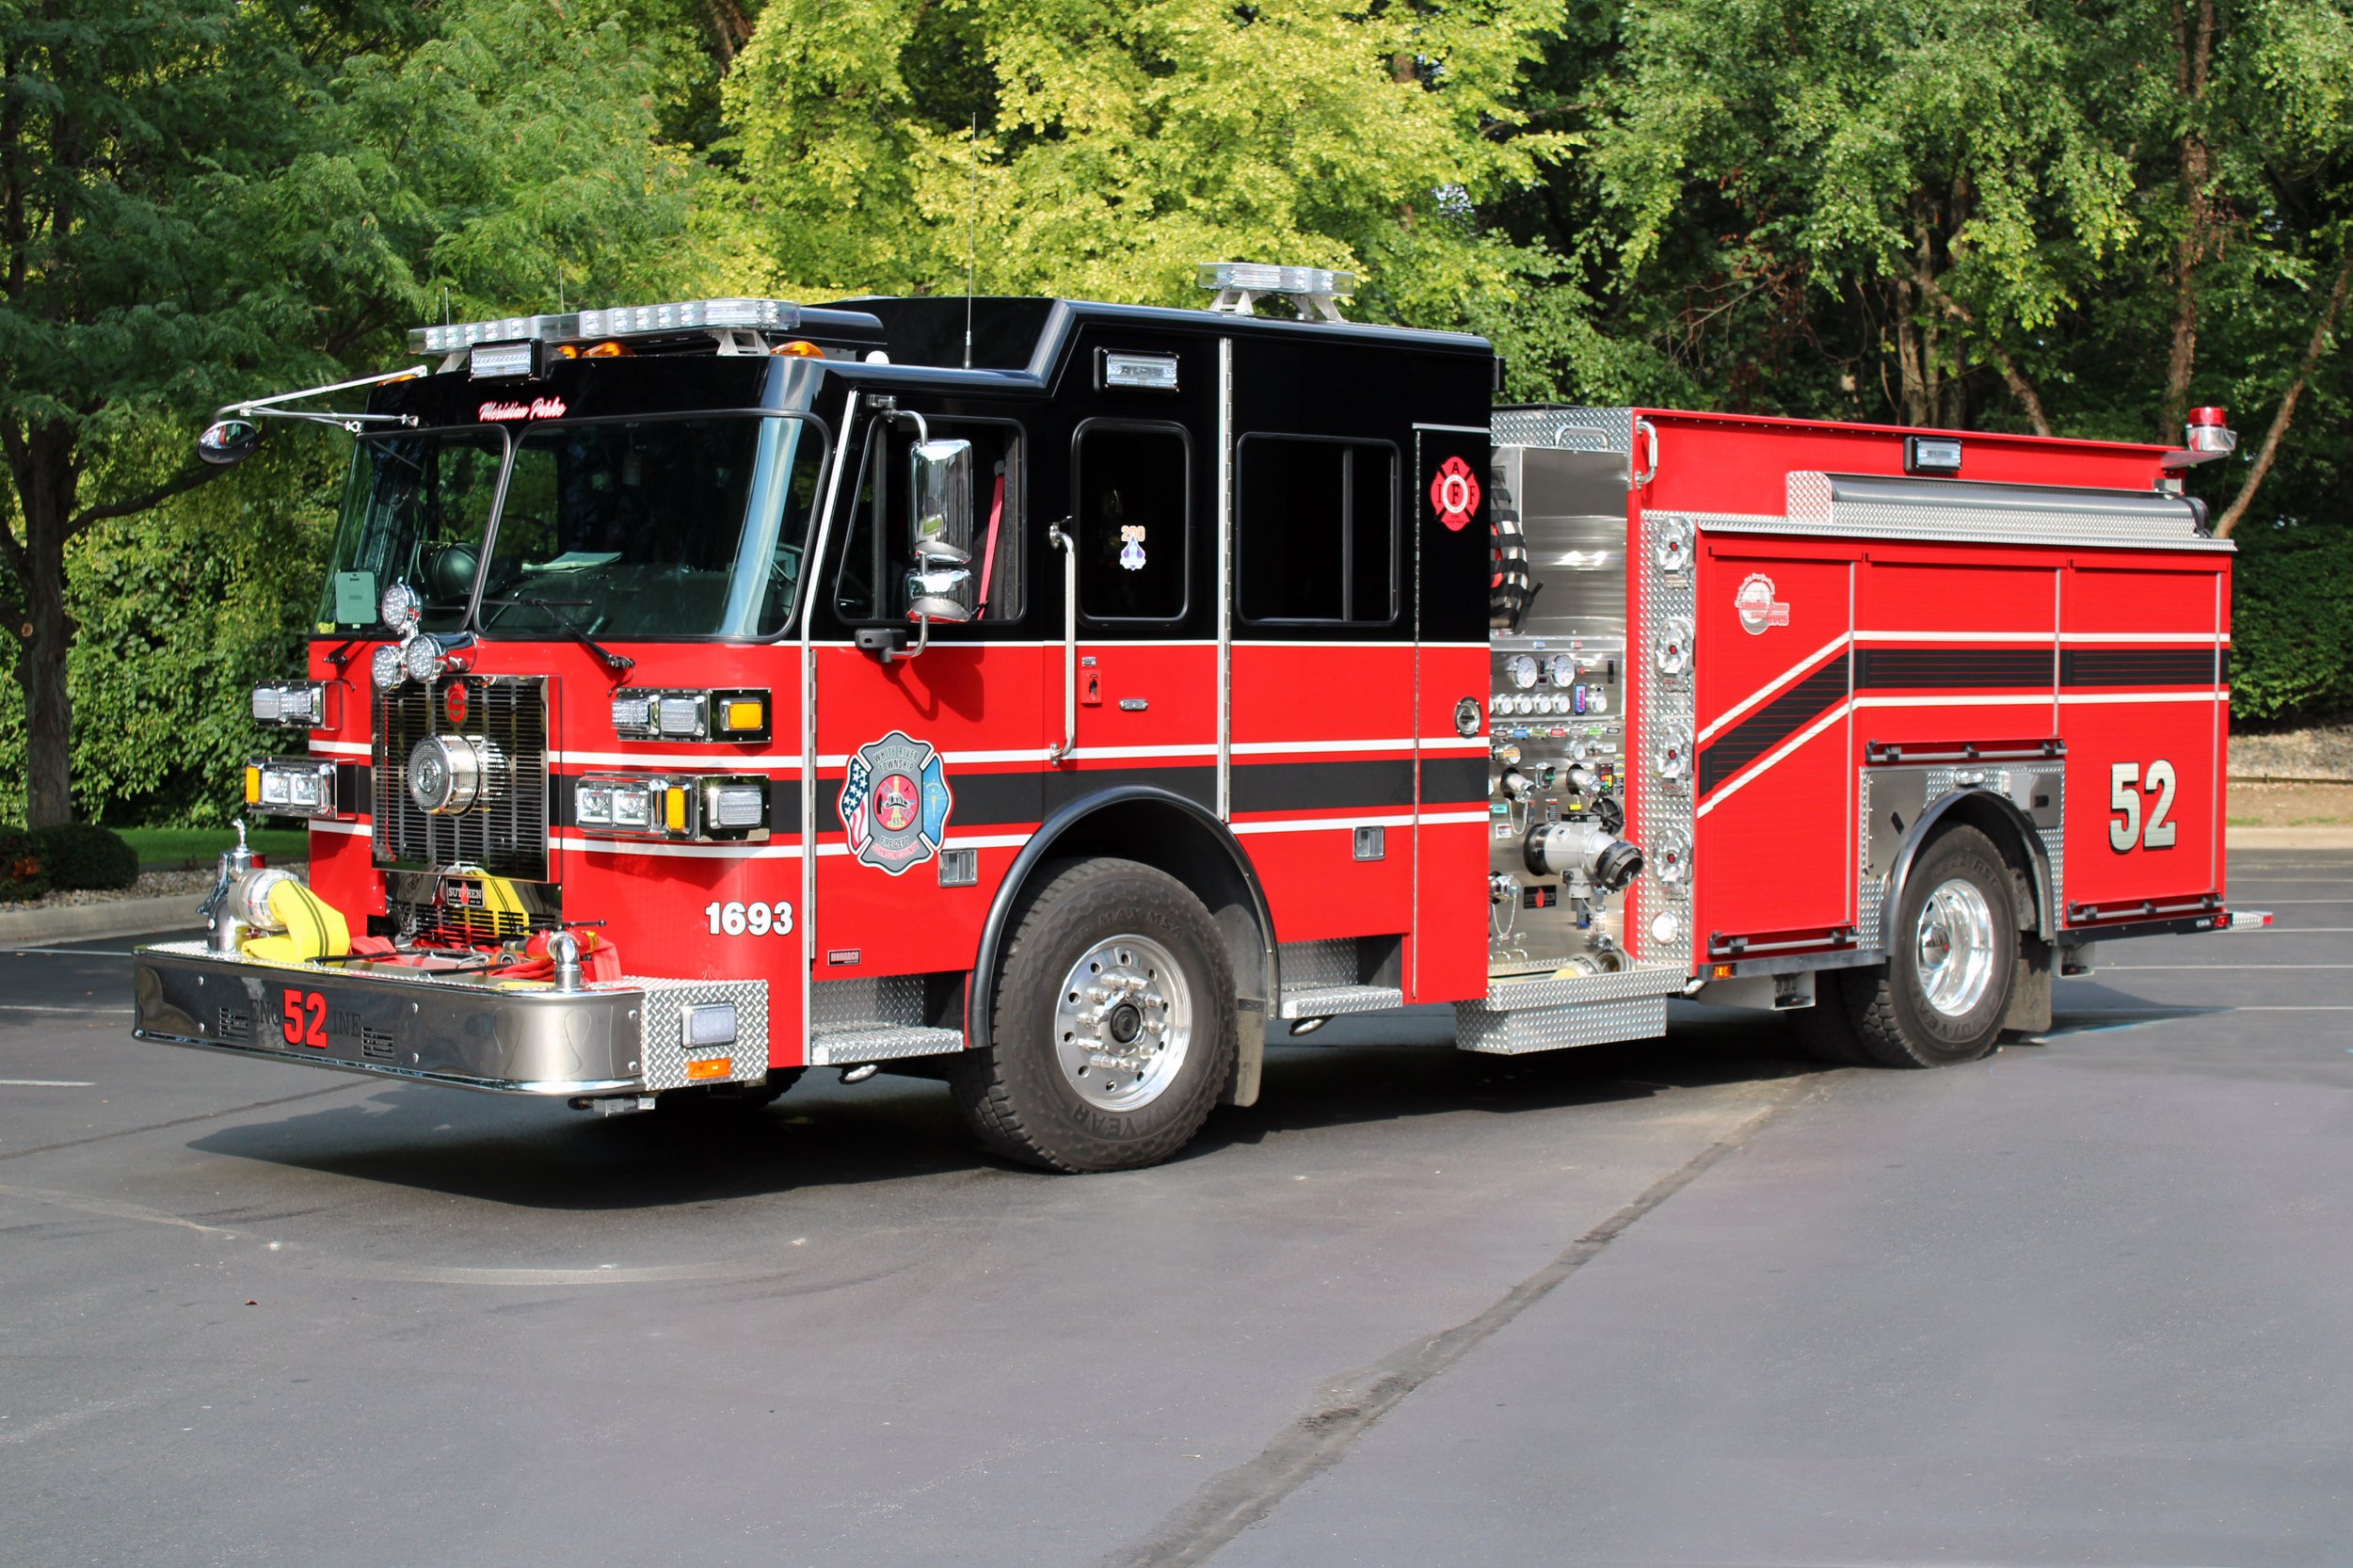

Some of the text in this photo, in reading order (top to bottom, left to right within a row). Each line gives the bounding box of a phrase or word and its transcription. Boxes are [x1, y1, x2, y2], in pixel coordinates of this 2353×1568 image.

[478, 401, 529, 422] Meridian
[1450, 462, 1461, 474] A
[1451, 483, 1460, 504] F
[1468, 486, 1475, 505] F
[873, 745, 920, 762] WHITE RIVER
[878, 758, 915, 774] TOWNSHIP
[2109, 759, 2177, 854] 52
[880, 836, 909, 848] FIRE DEPT
[448, 887, 482, 900] SUTPHEN
[1525, 892, 1556, 902] SUTEN
[705, 901, 793, 936] 1693
[1097, 907, 1184, 940] MAX MSA
[830, 951, 859, 962] MONARCH
[283, 988, 328, 1048] 52
